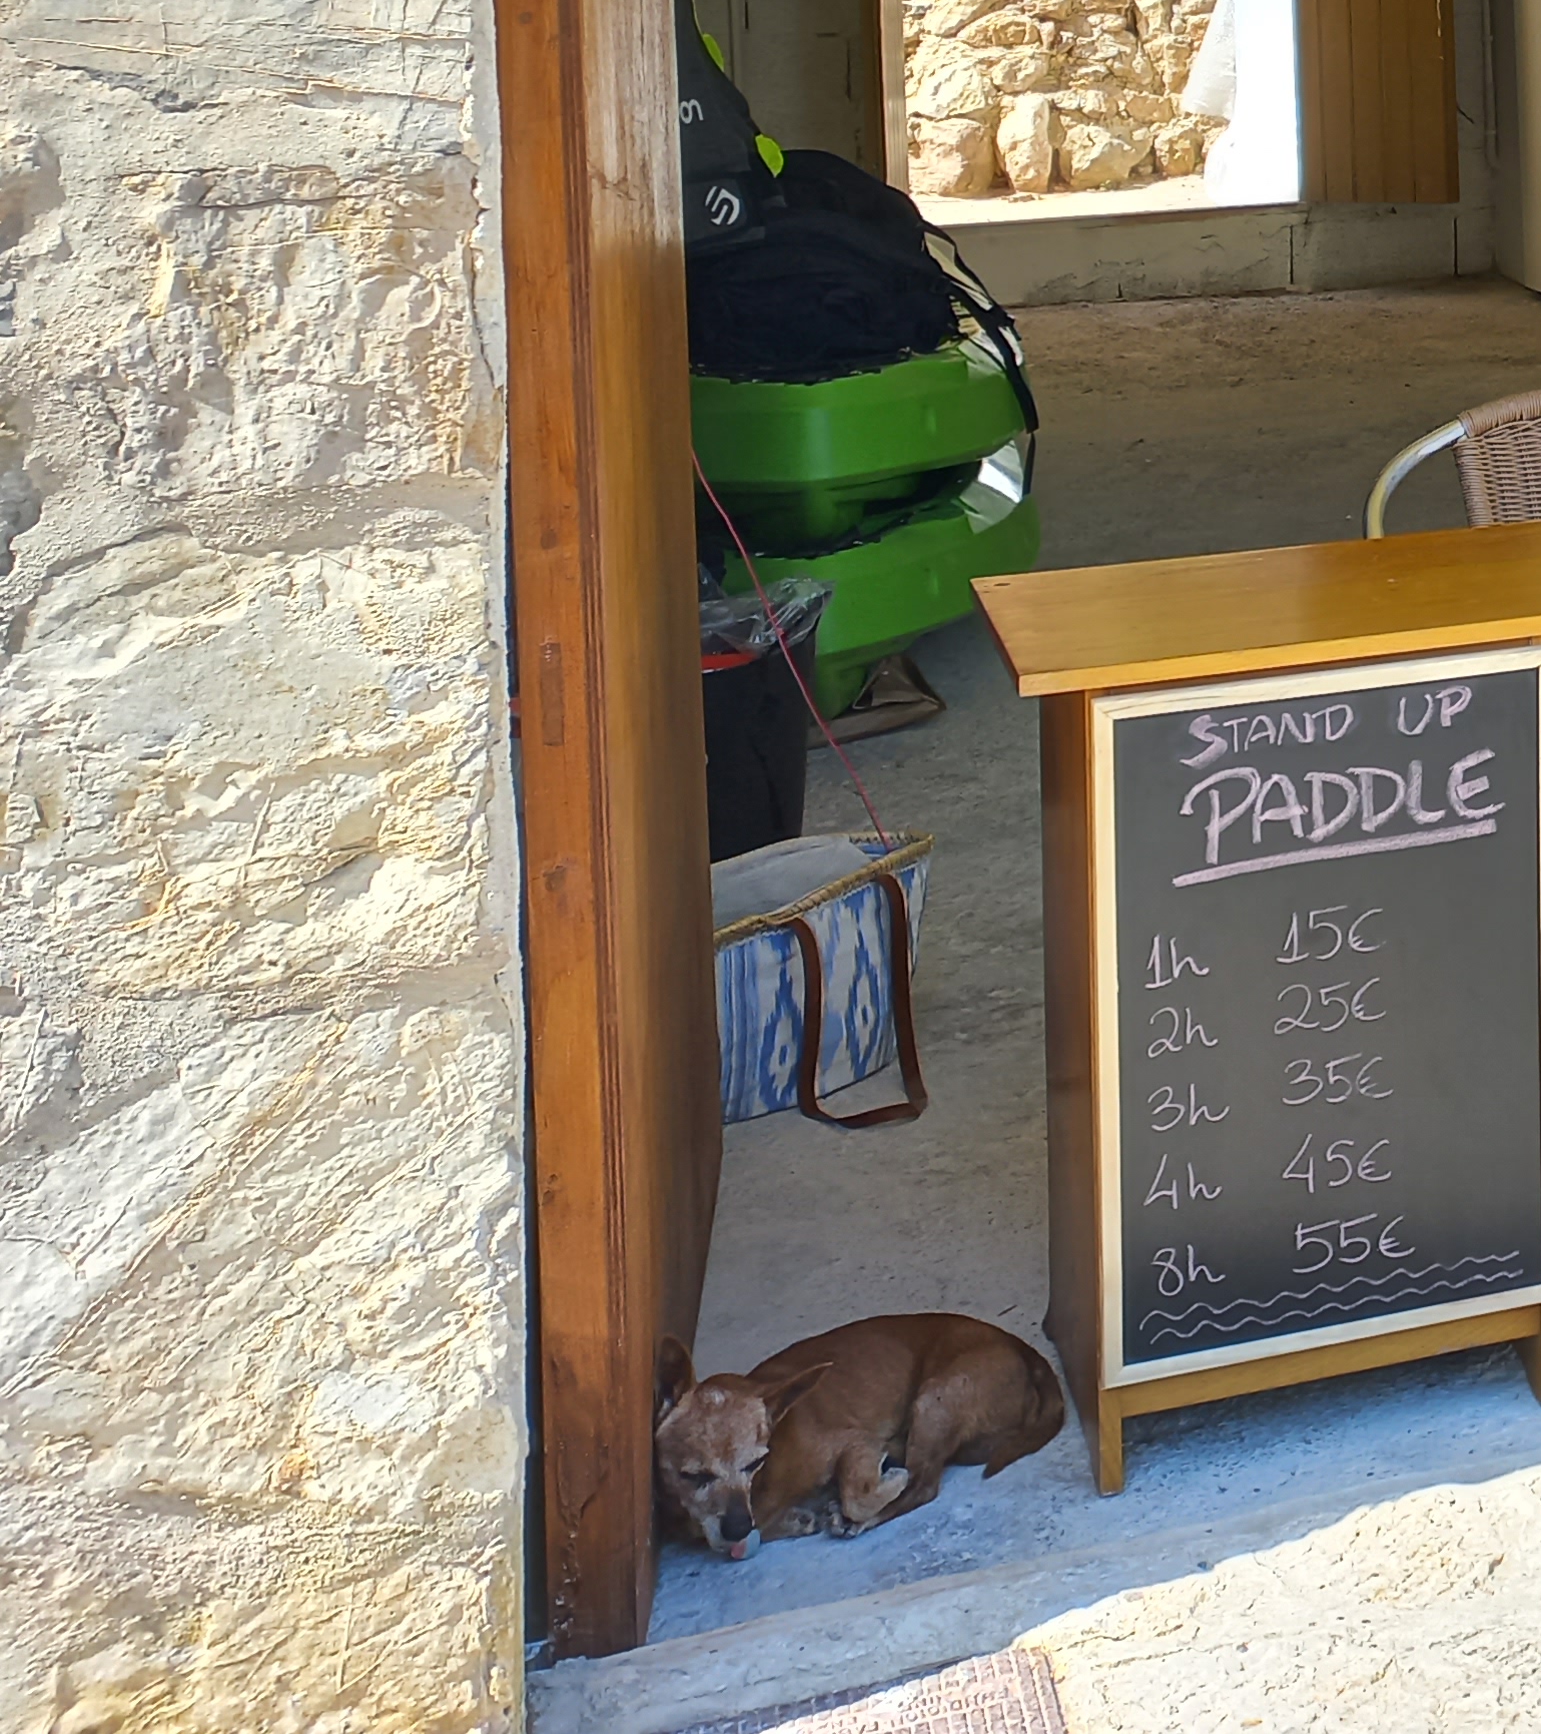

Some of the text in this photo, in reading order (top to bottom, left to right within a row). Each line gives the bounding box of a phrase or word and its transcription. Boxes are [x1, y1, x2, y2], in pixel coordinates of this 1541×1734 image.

[1179, 685, 1473, 769] STAND UP
[1179, 748, 1506, 865] PADDLE
[1144, 904, 1387, 990] 1h 15€
[1147, 976, 1387, 1058] 2h 25€
[1147, 1053, 1394, 1132] 3h 35€
[1143, 1133, 1393, 1210] 4h 45€
[1150, 1212, 1416, 1297] 8h 55€
